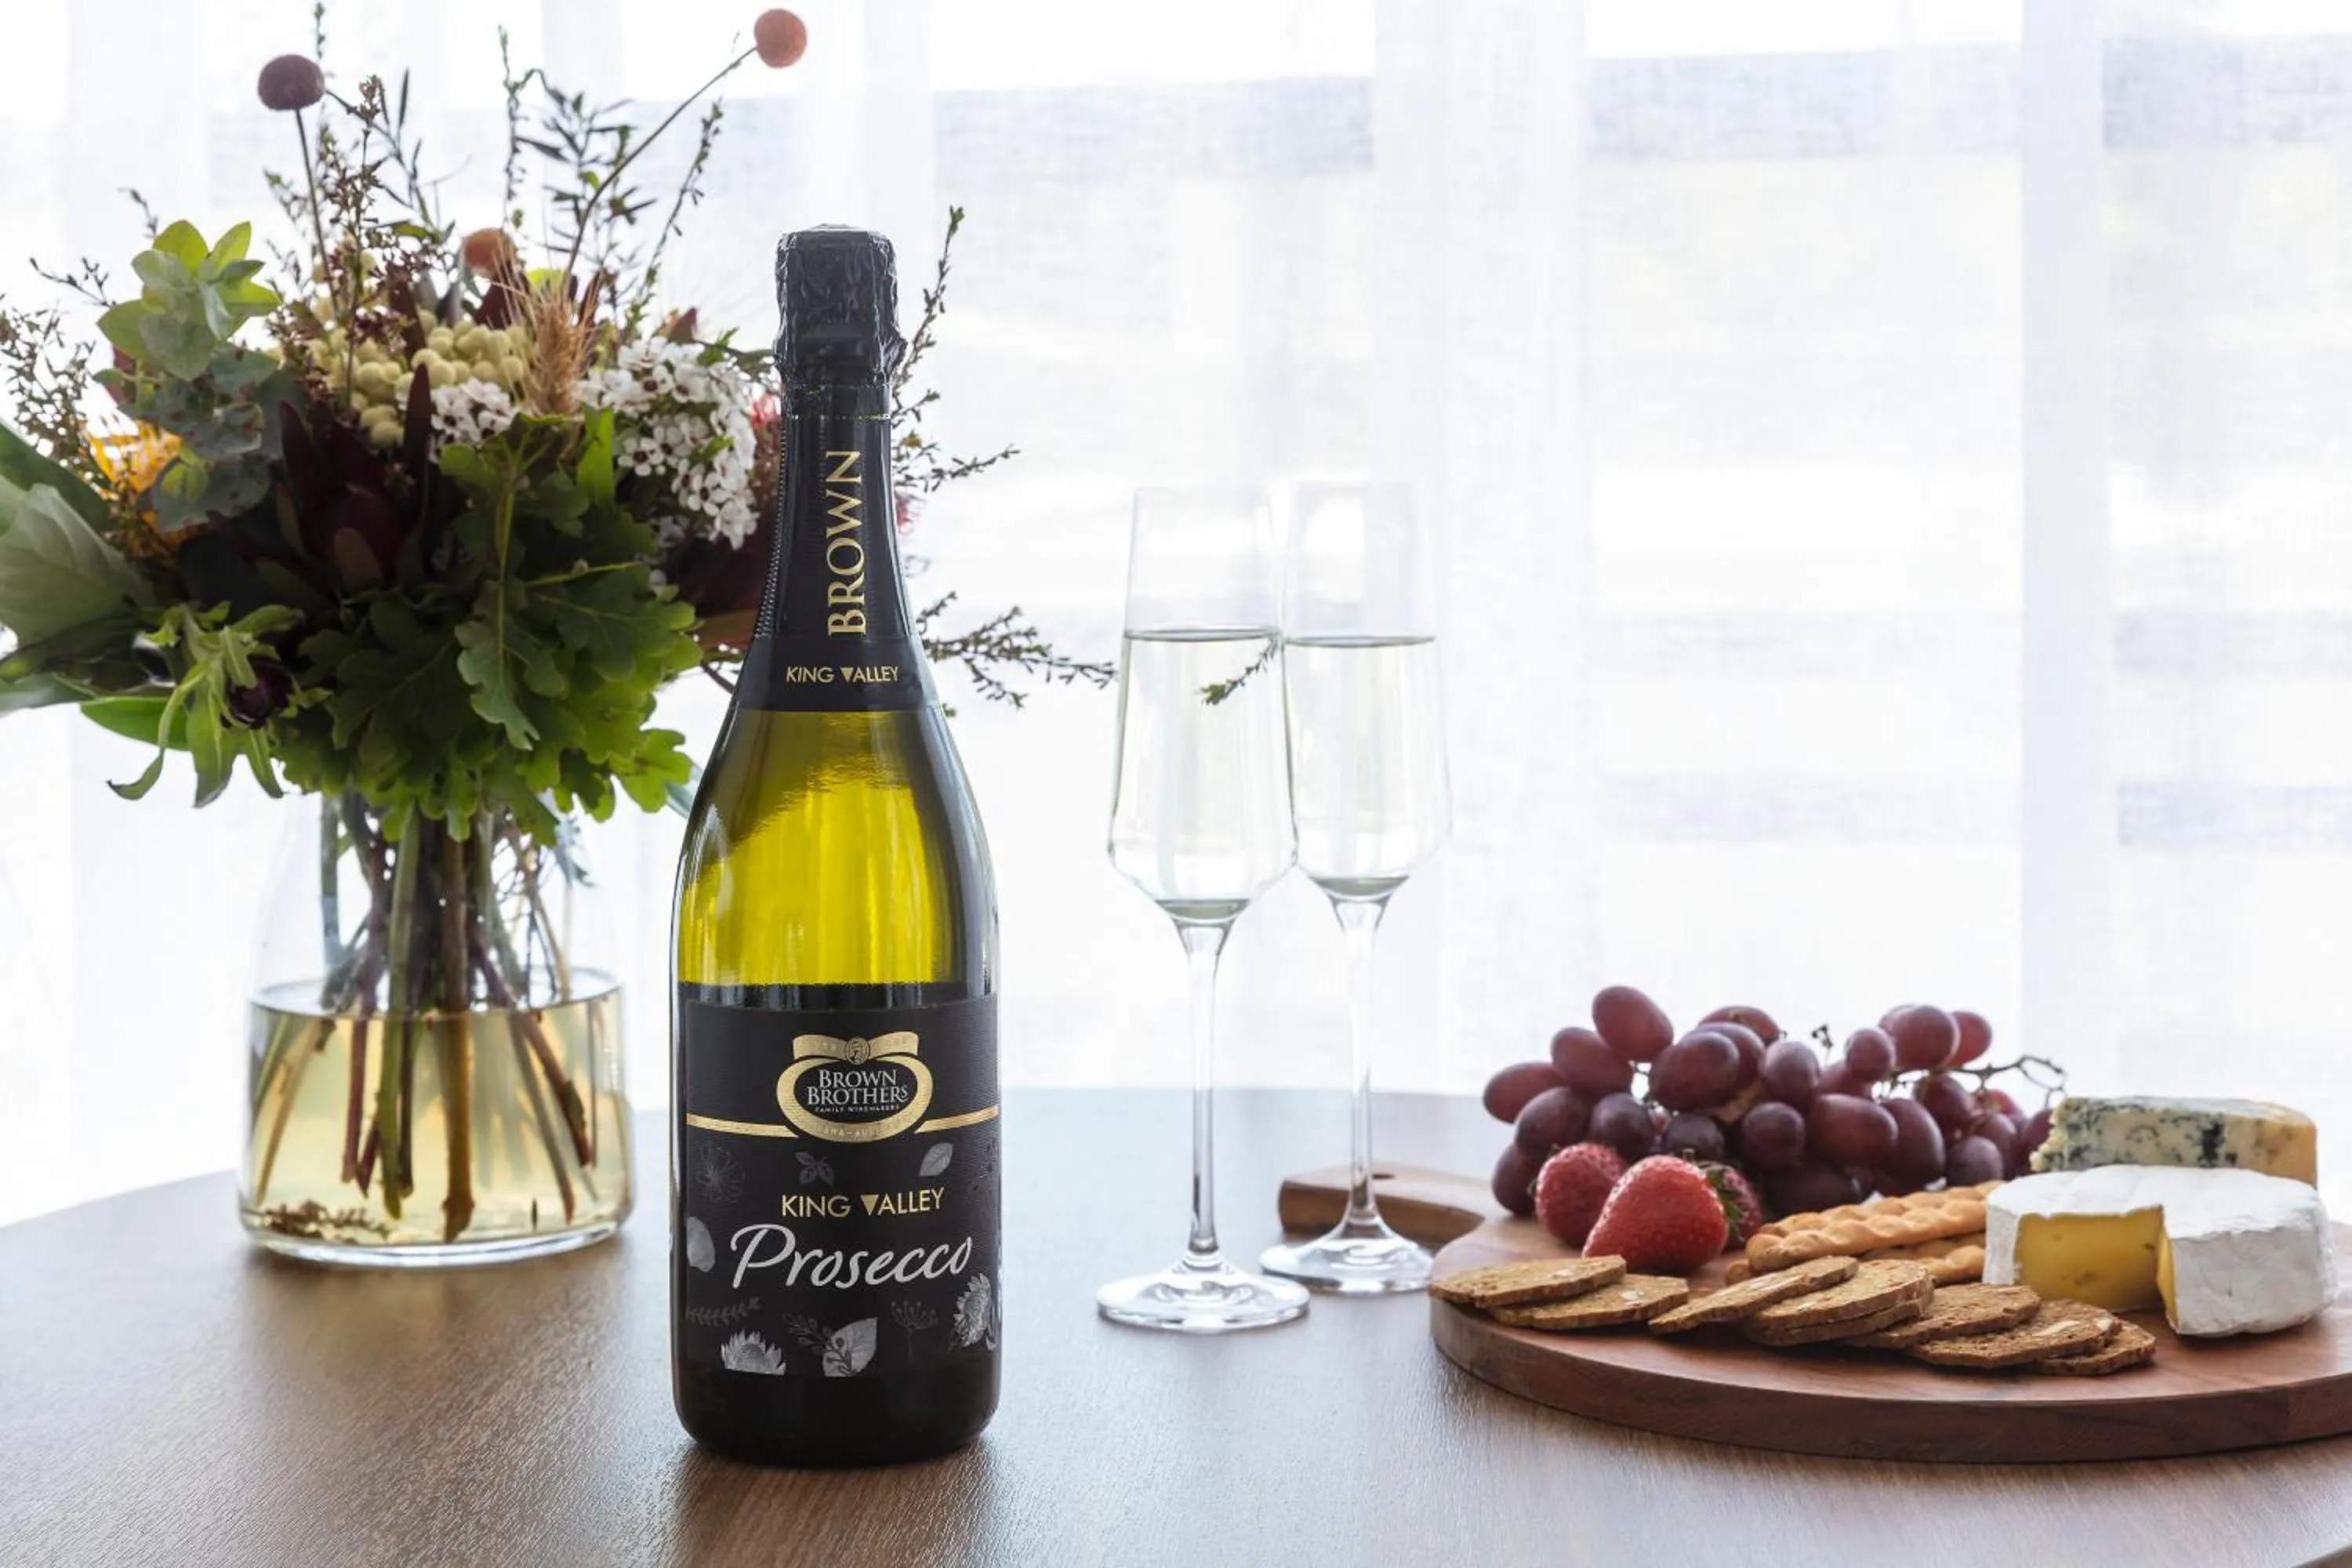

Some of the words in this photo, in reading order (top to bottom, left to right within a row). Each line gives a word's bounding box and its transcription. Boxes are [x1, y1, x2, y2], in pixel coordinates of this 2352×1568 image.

[826, 450, 866, 636] BROWN
[786, 666, 834, 683] KING
[840, 666, 898, 683] VALLEY
[818, 1069, 897, 1088] BROWN
[807, 1084, 908, 1105] BROTHERS
[782, 1194, 851, 1218] KING
[860, 1186, 945, 1216] VALLEY
[730, 1224, 972, 1289] Prosecco
